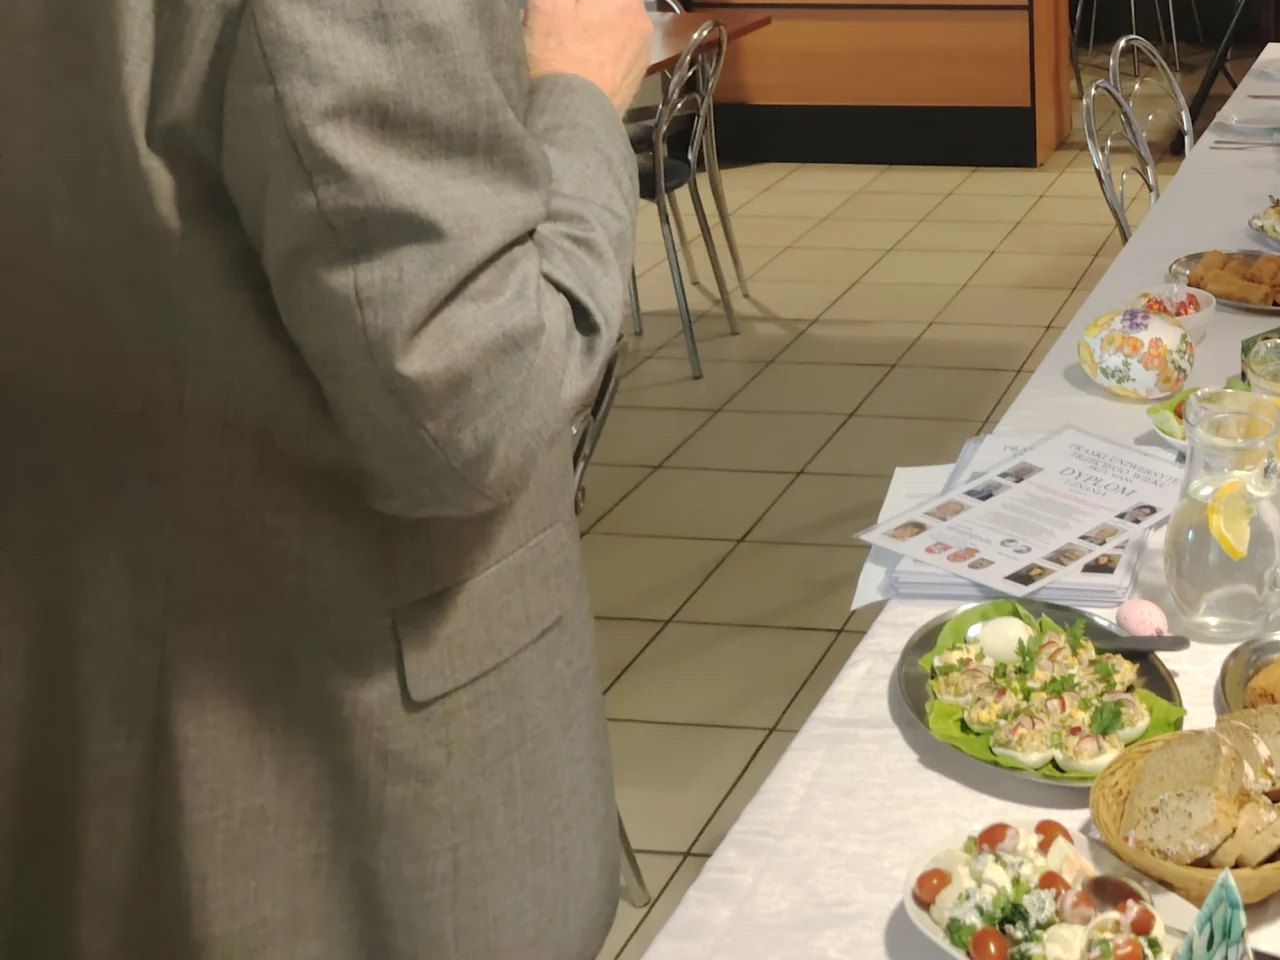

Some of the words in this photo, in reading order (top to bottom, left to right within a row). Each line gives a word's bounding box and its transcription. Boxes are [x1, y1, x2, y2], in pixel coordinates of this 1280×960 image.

[1069, 443, 1109, 460] PRASKI
[1110, 456, 1180, 484] UNIWERSYTE
[1070, 452, 1130, 476] TRZECIEGO
[1132, 470, 1168, 488] WIEKU
[1059, 467, 1137, 497] DYPLOM
